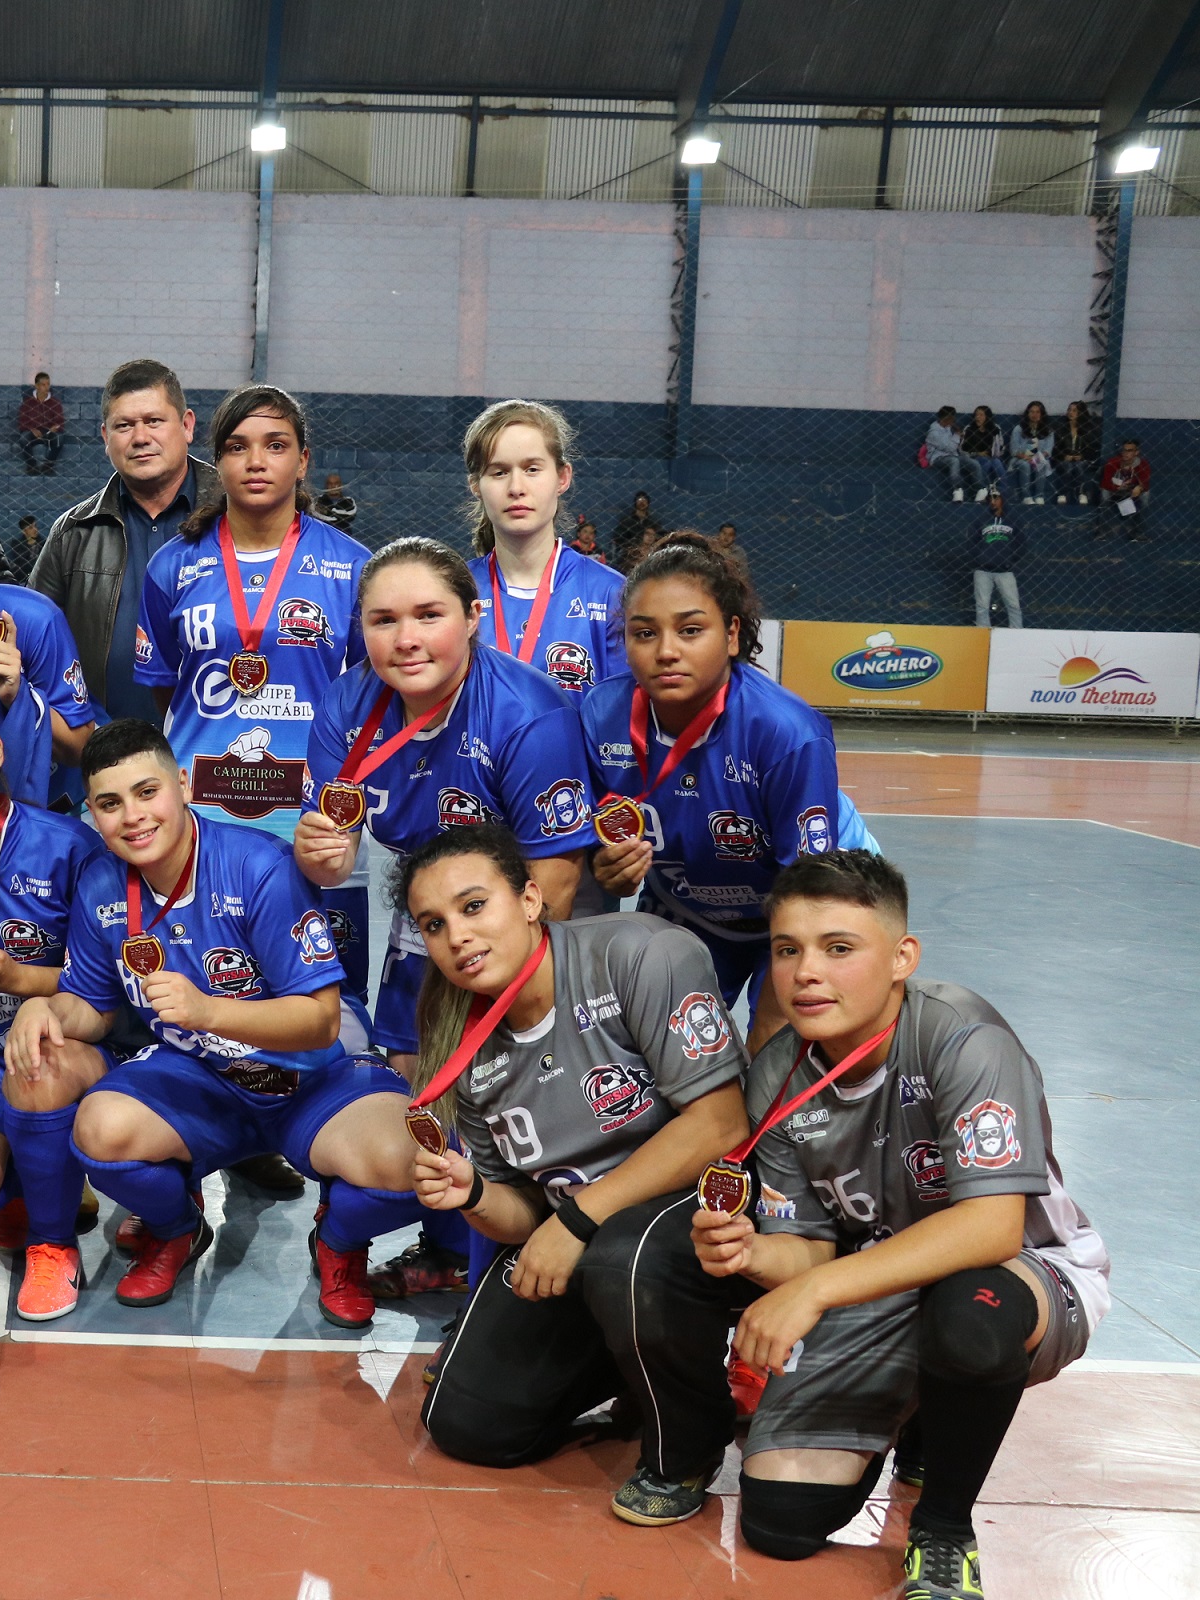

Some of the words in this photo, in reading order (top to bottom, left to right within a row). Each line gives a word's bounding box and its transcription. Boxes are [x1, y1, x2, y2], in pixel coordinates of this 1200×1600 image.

[182, 603, 217, 652] 18
[280, 618, 322, 633] FUTSAL
[549, 662, 588, 677] FUTSAL
[840, 655, 933, 677] LANCHERO
[1030, 689, 1077, 704] novo
[1081, 686, 1157, 705] thermas
[239, 702, 313, 717] CONTÁBIL
[213, 766, 286, 780] CAMPEIROS
[231, 780, 269, 791] GRILL
[692, 887, 750, 896] EQUIPE
[129, 943, 153, 953] COPA
[210, 967, 254, 985] FUTSAL
[591, 1081, 640, 1113] FUTSAL
